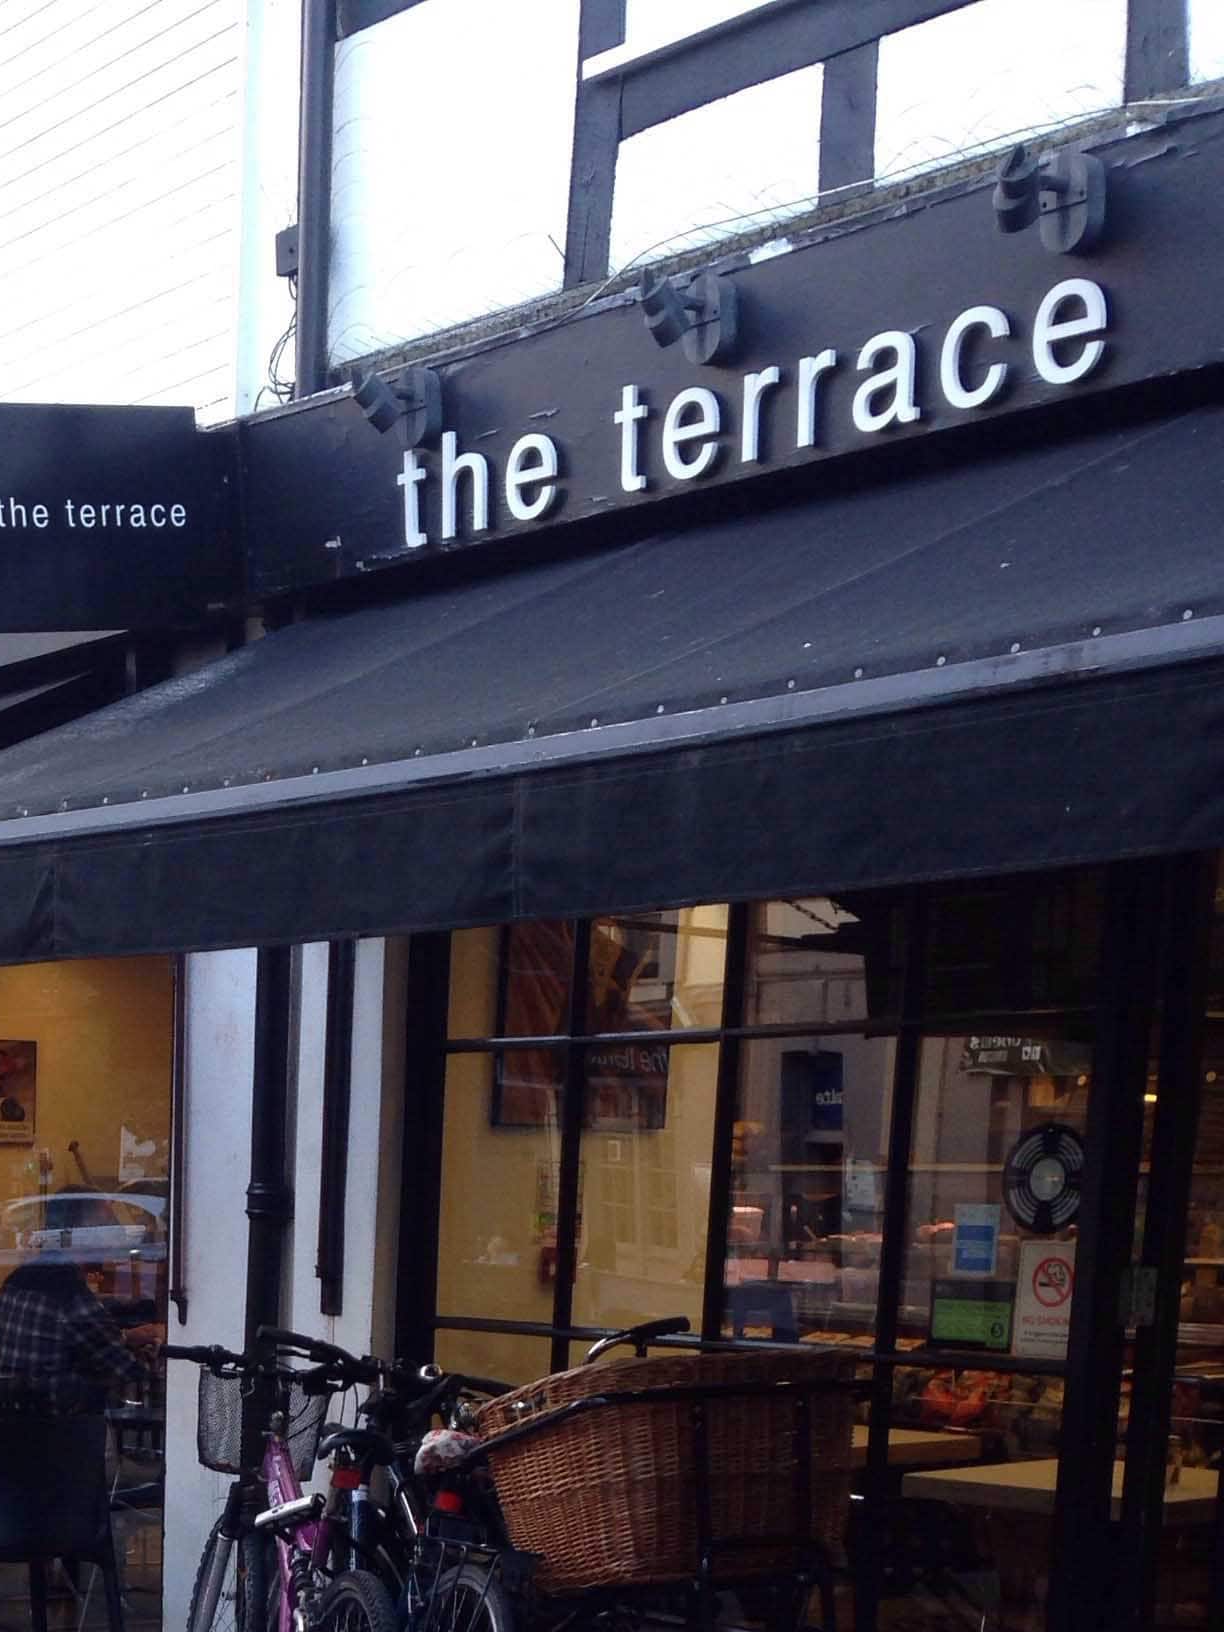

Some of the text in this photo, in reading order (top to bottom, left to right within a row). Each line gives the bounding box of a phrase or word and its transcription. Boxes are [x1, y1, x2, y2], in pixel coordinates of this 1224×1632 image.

[396, 278, 1107, 548] the terrace
[64, 499, 187, 528] terrace
